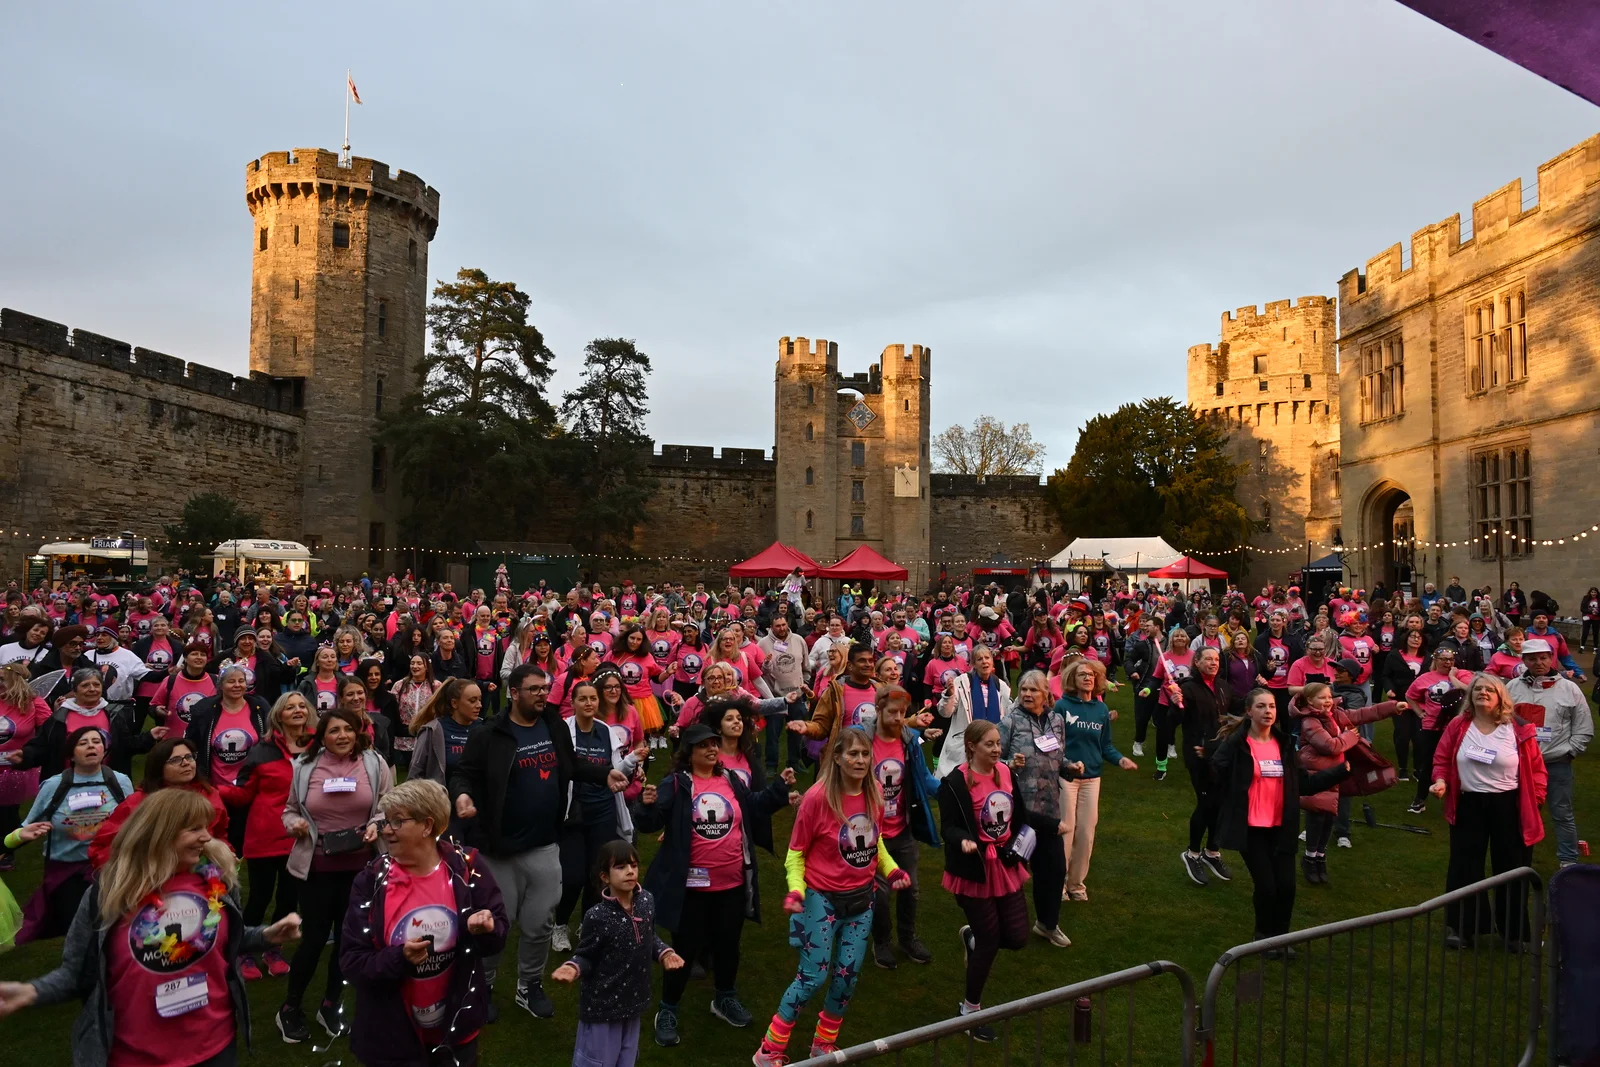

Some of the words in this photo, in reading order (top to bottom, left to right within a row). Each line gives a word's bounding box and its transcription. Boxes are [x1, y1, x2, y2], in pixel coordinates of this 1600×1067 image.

[93, 539, 120, 549] FRIARY
[696, 823, 729, 832] MOONLIGHT
[846, 847, 877, 860] MOONLIGHT
[856, 856, 870, 864] WALK
[421, 919, 449, 932] myton
[416, 963, 442, 974] WALK
[164, 981, 181, 992] 287
